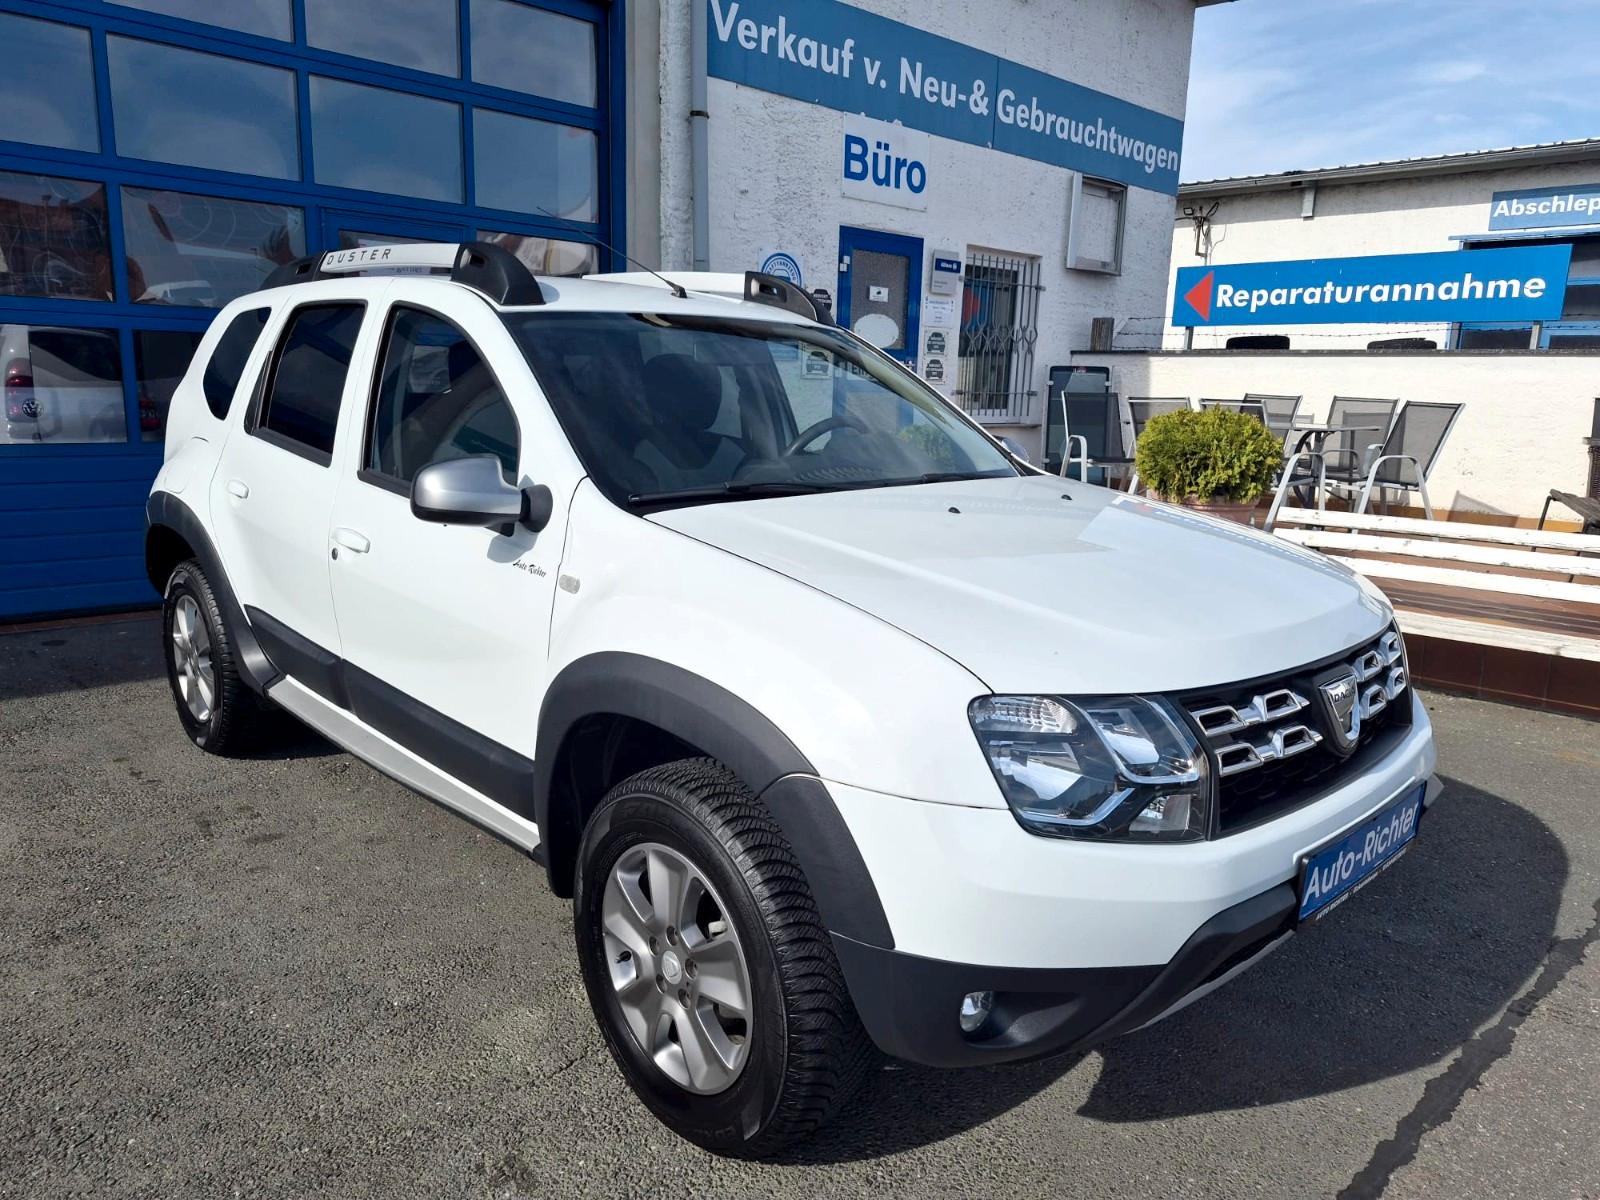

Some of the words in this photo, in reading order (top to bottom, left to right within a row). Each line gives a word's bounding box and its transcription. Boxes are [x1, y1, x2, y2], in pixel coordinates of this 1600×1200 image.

[711, 0, 855, 78] Verkauf
[863, 56, 887, 89] v.
[997, 88, 1179, 174] Gebrauchtwagen
[844, 133, 927, 194] Büro
[326, 248, 392, 266] DUSTER
[1215, 272, 1547, 313] Reparaturannahme
[1302, 801, 1419, 907] Auto-Richter
